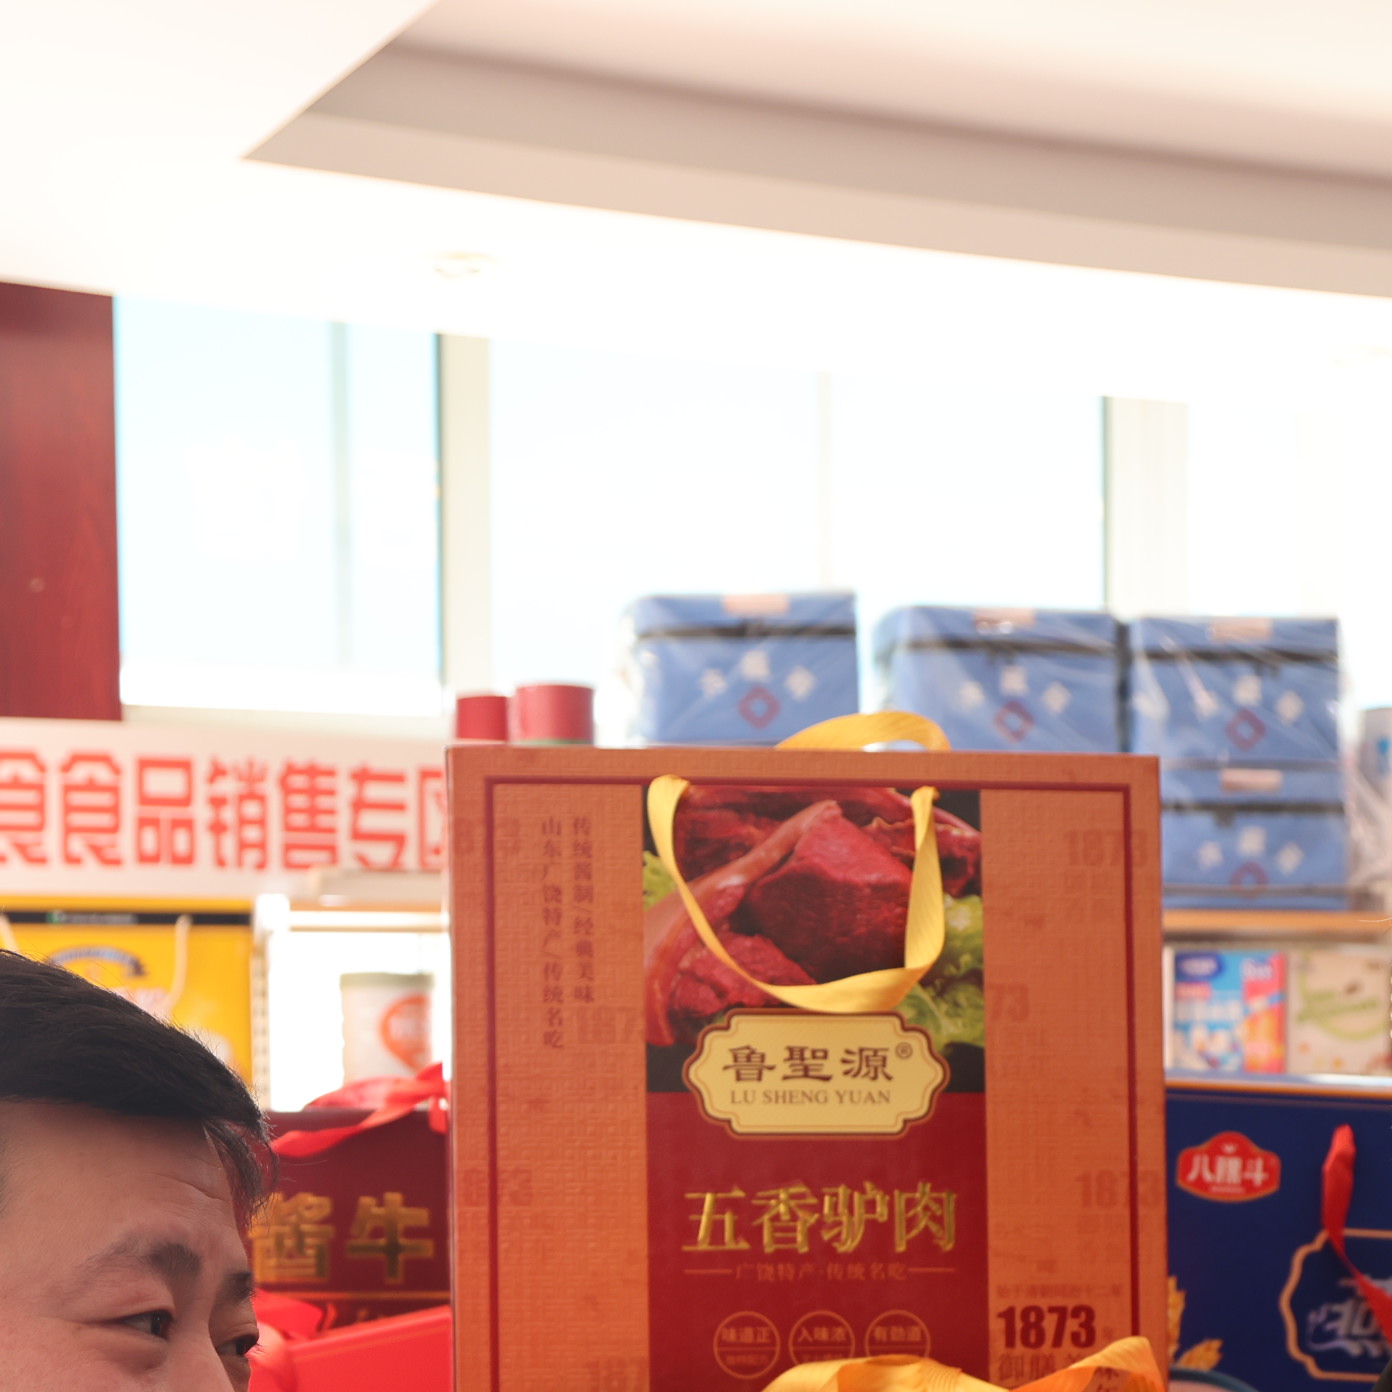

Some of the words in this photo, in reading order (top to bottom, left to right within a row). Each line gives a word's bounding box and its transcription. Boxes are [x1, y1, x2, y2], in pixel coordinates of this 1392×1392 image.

[723, 1045, 894, 1082] 鲁聖源
[731, 1090, 755, 1104] LU
[762, 1090, 828, 1105] SHENG
[834, 1090, 891, 1104] YUAN
[682, 1181, 956, 1253] 五香驴肉
[997, 1304, 1096, 1349] 1873
